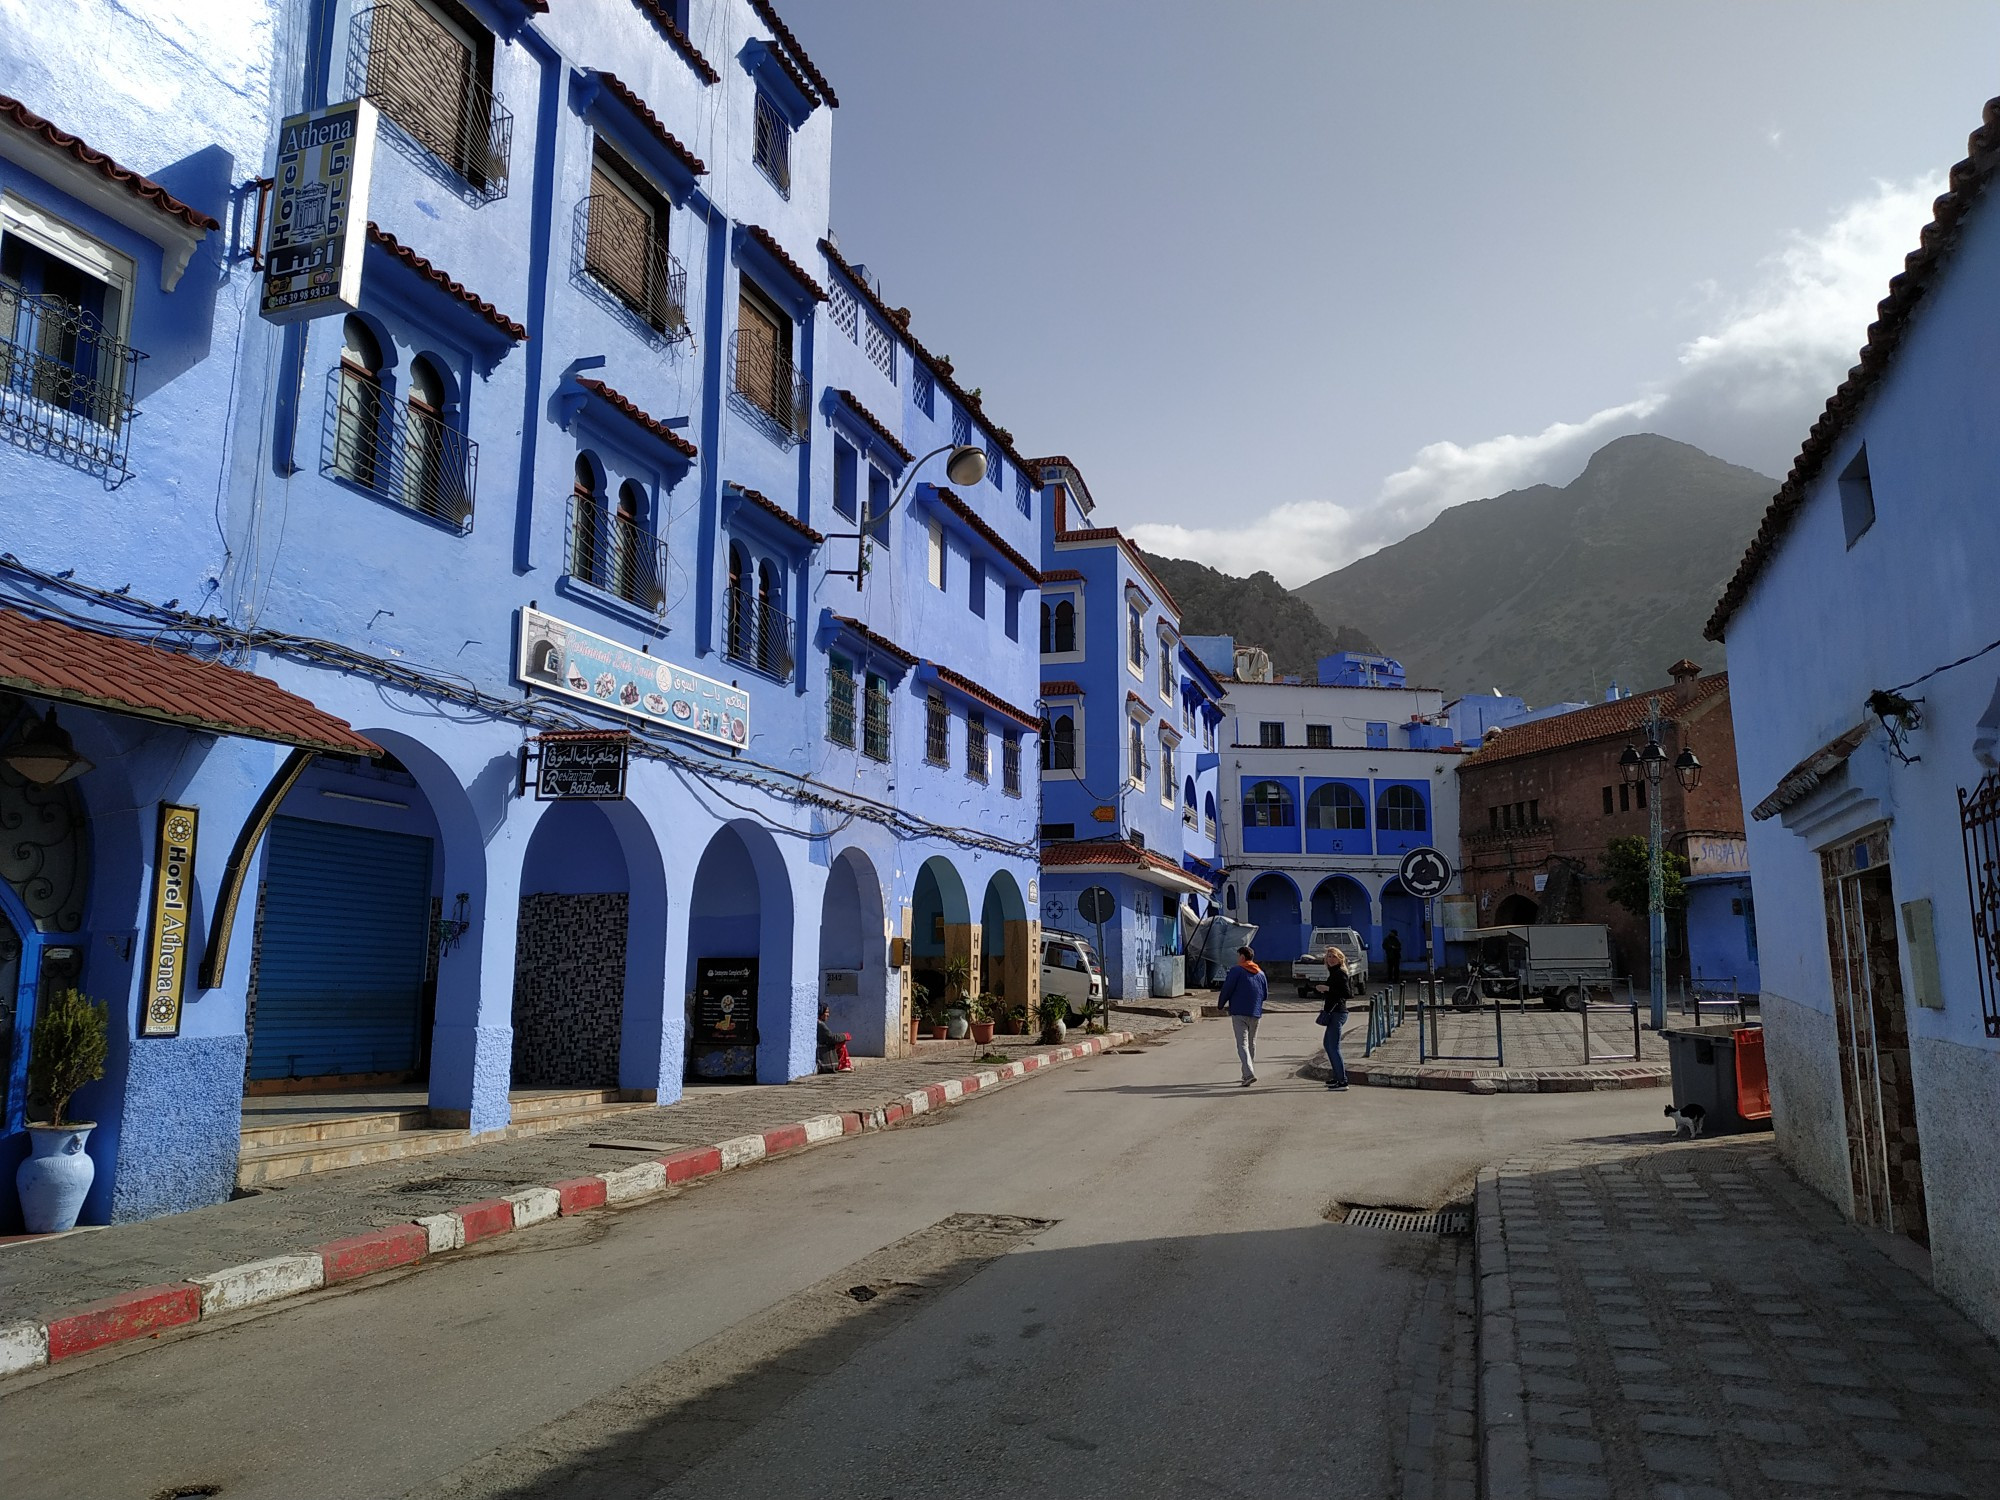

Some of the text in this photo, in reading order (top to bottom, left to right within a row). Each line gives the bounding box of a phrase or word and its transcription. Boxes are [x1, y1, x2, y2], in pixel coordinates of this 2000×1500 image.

[283, 119, 352, 154] Athena
[272, 153, 298, 248] Hotel
[327, 141, 349, 236] فندق
[271, 239, 335, 276] أثينا
[673, 673, 746, 711] مطعم باب السوق
[569, 781, 617, 794] Bab Souk
[164, 845, 188, 910] Hotel
[155, 912, 185, 993] Athena
